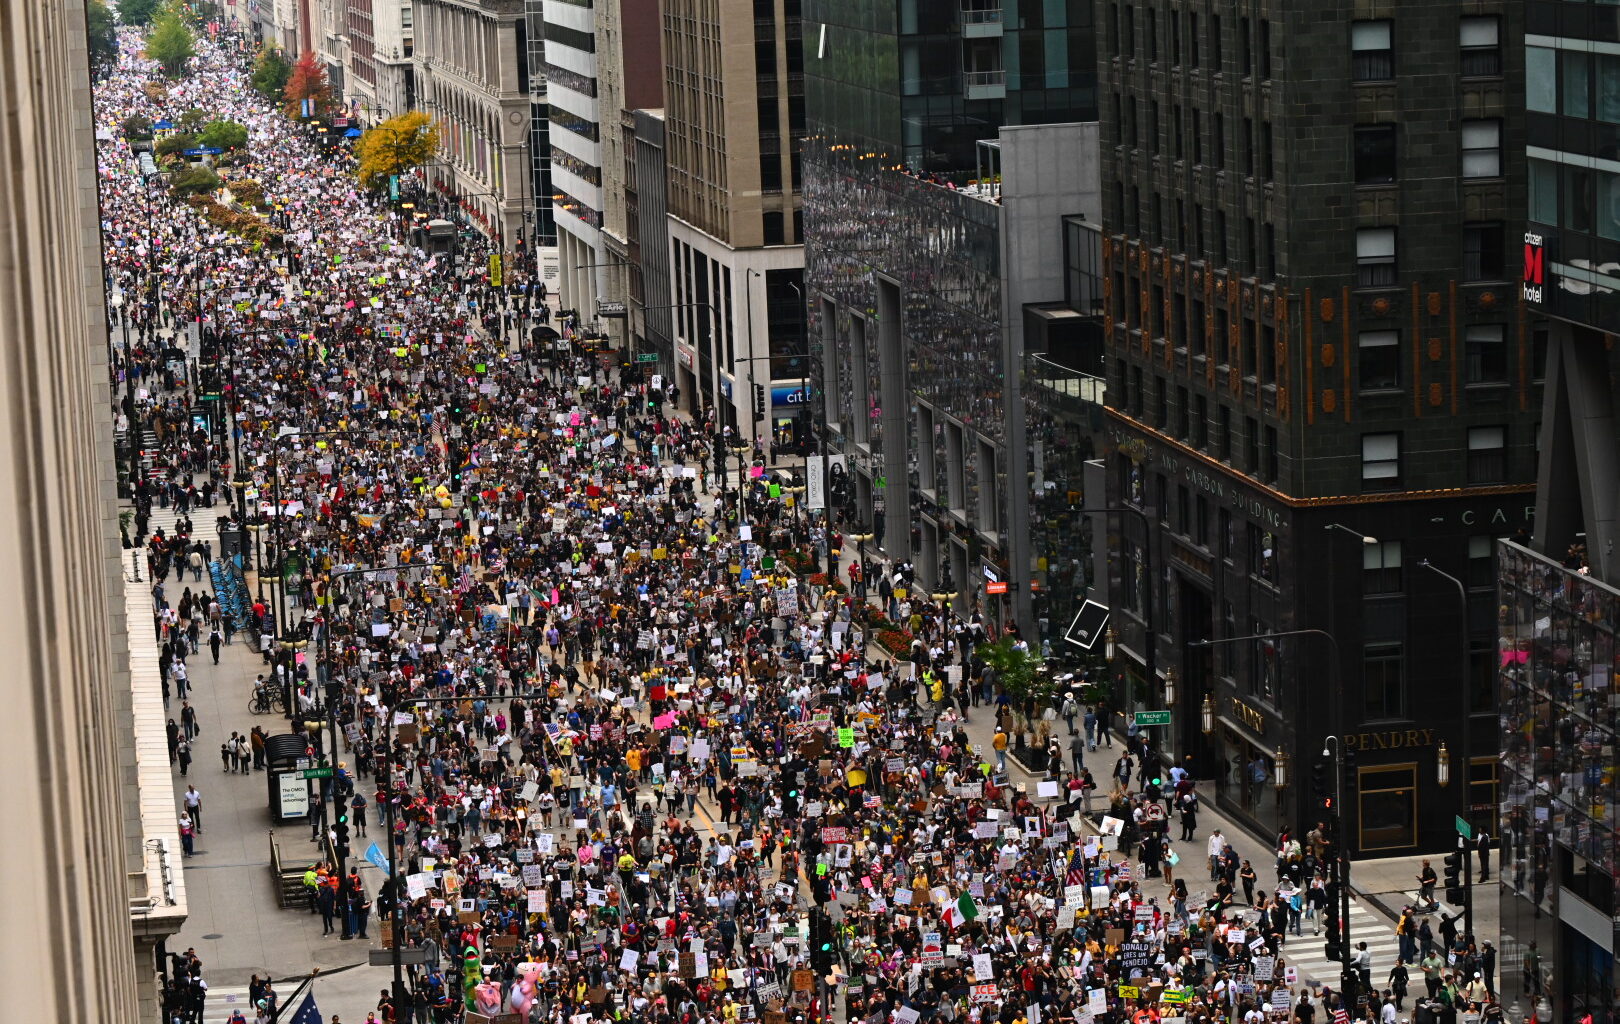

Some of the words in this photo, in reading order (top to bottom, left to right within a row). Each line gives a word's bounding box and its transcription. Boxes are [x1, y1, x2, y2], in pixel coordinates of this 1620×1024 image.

[1524, 230, 1543, 246] citizen
[1523, 282, 1542, 303] hotel
[1161, 453, 1178, 474] AND
[1185, 466, 1224, 497] CARBON
[1231, 490, 1280, 527] BUILDING
[1231, 697, 1264, 735] PENDRY
[1344, 729, 1437, 751] PENDRY
[1122, 959, 1148, 967] PENDEJO
[974, 984, 996, 995] ICE
